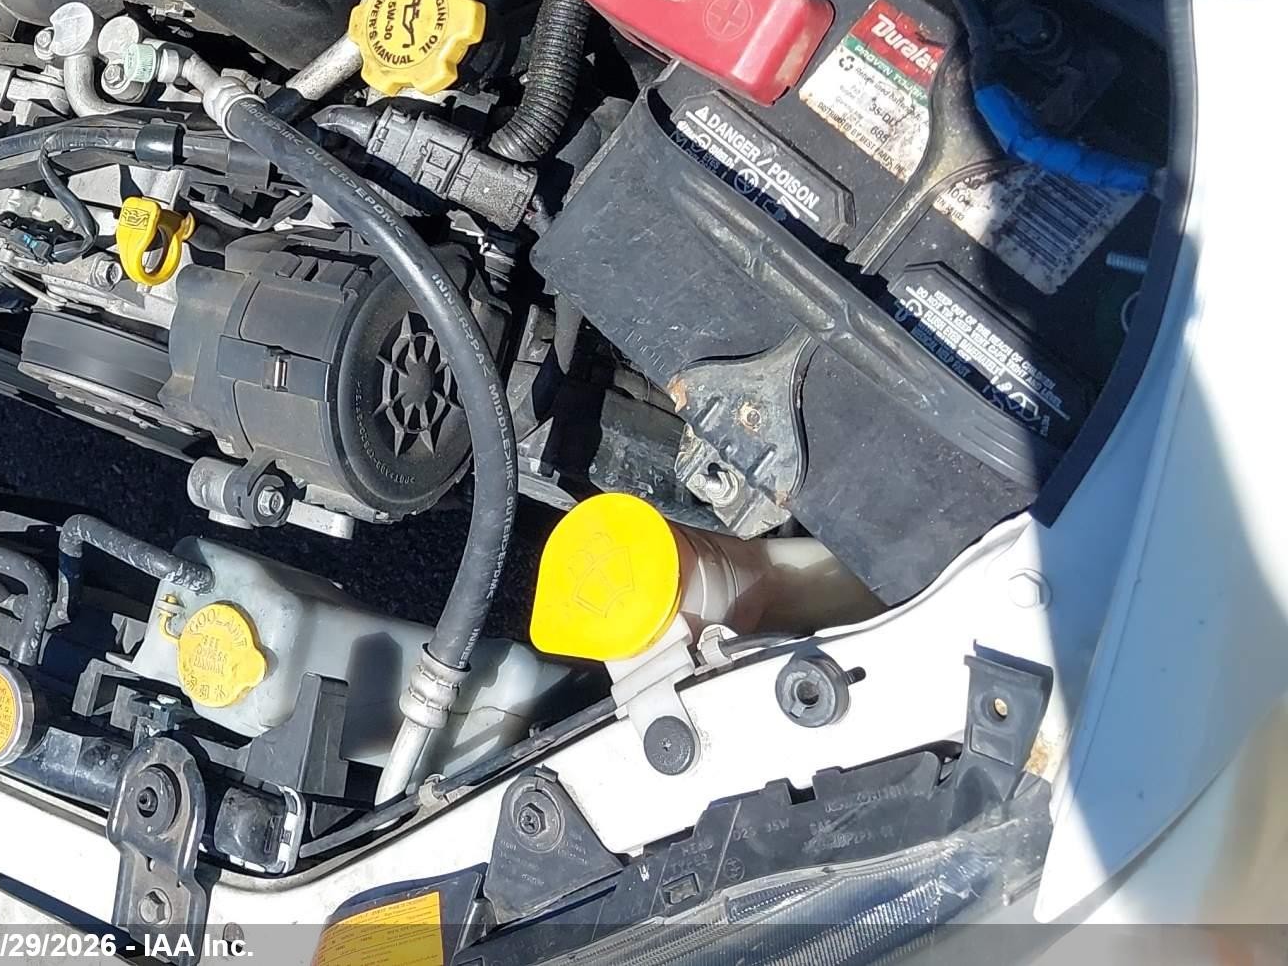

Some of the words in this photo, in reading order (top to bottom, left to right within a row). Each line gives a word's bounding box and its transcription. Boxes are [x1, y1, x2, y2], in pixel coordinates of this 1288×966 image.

[383, 1, 397, 40] 5W-30
[372, 41, 414, 65] MANUAL
[418, 34, 439, 55] OIL
[854, 45, 893, 76] PROVEN
[858, 135, 877, 151] BEST
[869, 125, 890, 144] 685
[706, 114, 763, 162] DANGER
[766, 164, 820, 210] POISON
[926, 295, 942, 310] NOT
[953, 317, 972, 334] KEEP
[987, 345, 1007, 362] CAPS
[950, 304, 966, 318] OUT
[975, 324, 991, 338] THE
[922, 310, 947, 332] FLUSH
[942, 326, 962, 344] EYES
[958, 340, 1002, 376] IMMEDIATELY
